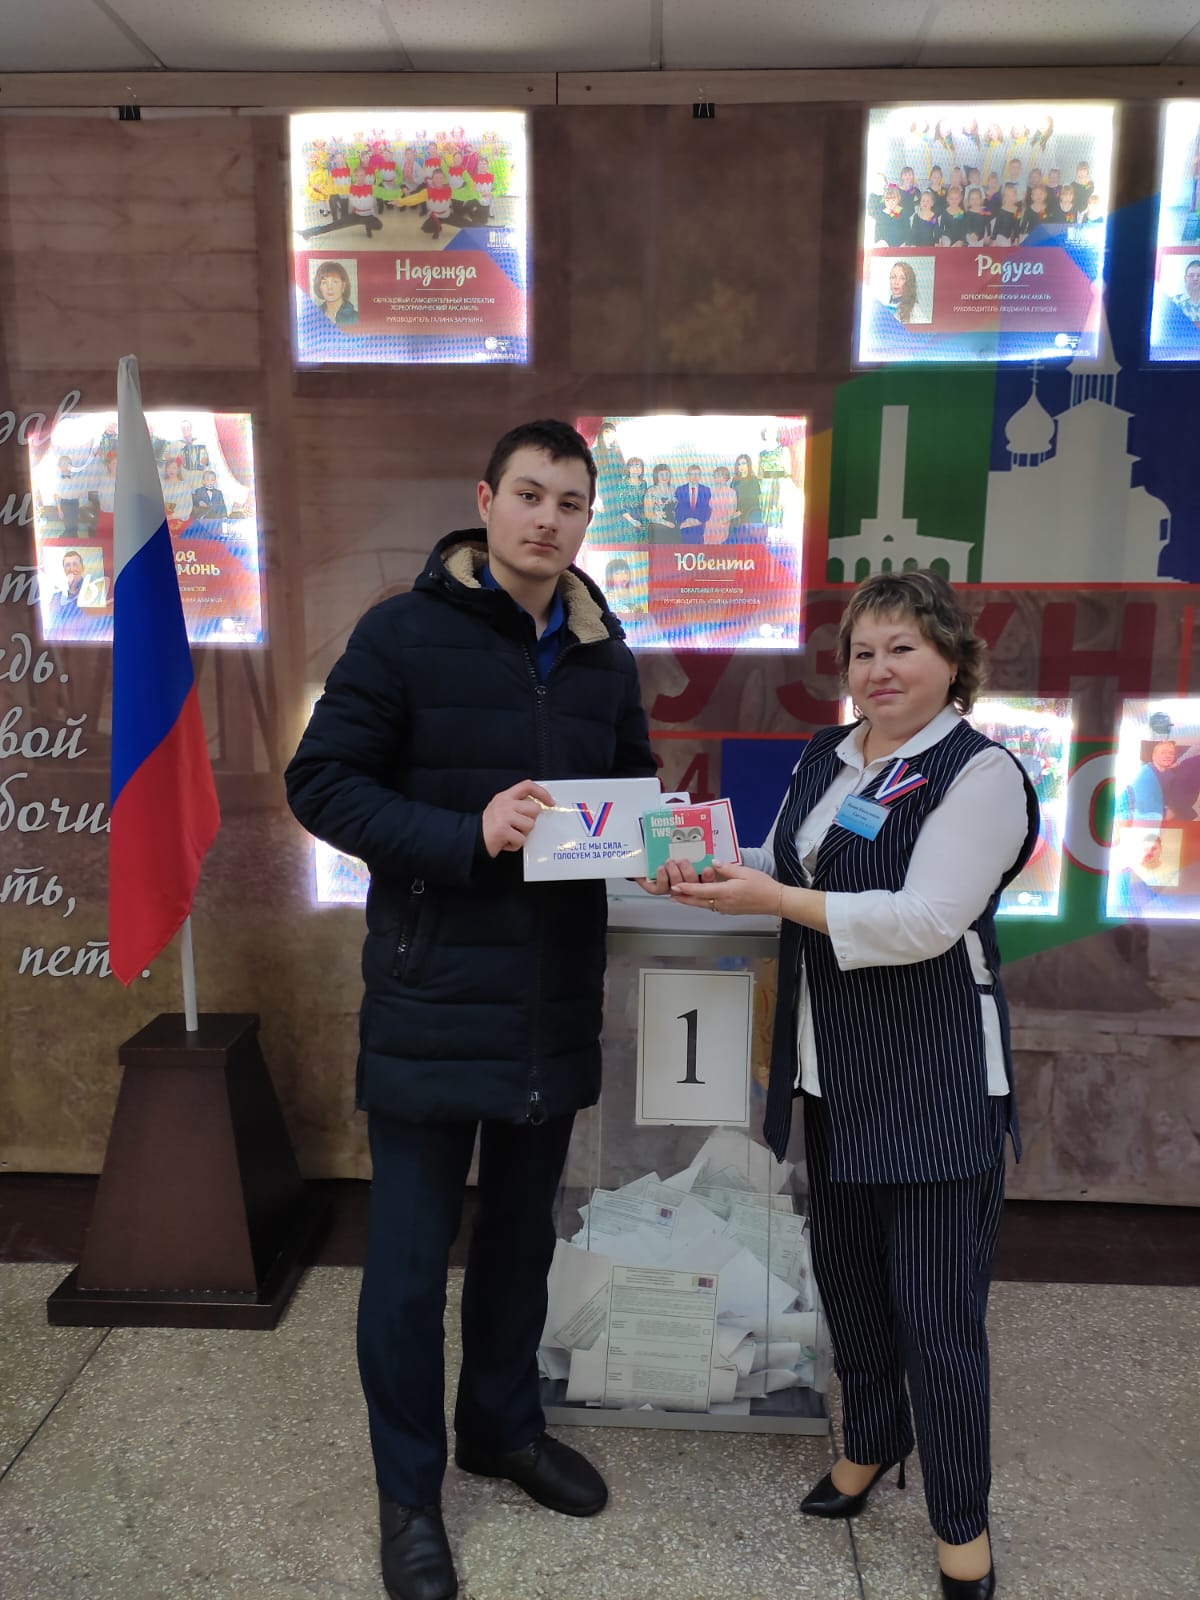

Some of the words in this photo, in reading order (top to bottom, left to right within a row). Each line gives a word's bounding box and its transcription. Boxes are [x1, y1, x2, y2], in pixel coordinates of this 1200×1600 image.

[395, 258, 477, 287] Надежда
[974, 254, 1044, 282] Радуга
[674, 552, 756, 571] Ювента
[650, 813, 685, 828] kenshi
[651, 827, 671, 838] TWS
[588, 842, 601, 850] МЫ
[603, 841, 622, 849] СИЛА
[553, 852, 591, 860] ГОЛОСУЕМ
[593, 851, 601, 859] ЗА
[676, 1009, 706, 1084] 1
